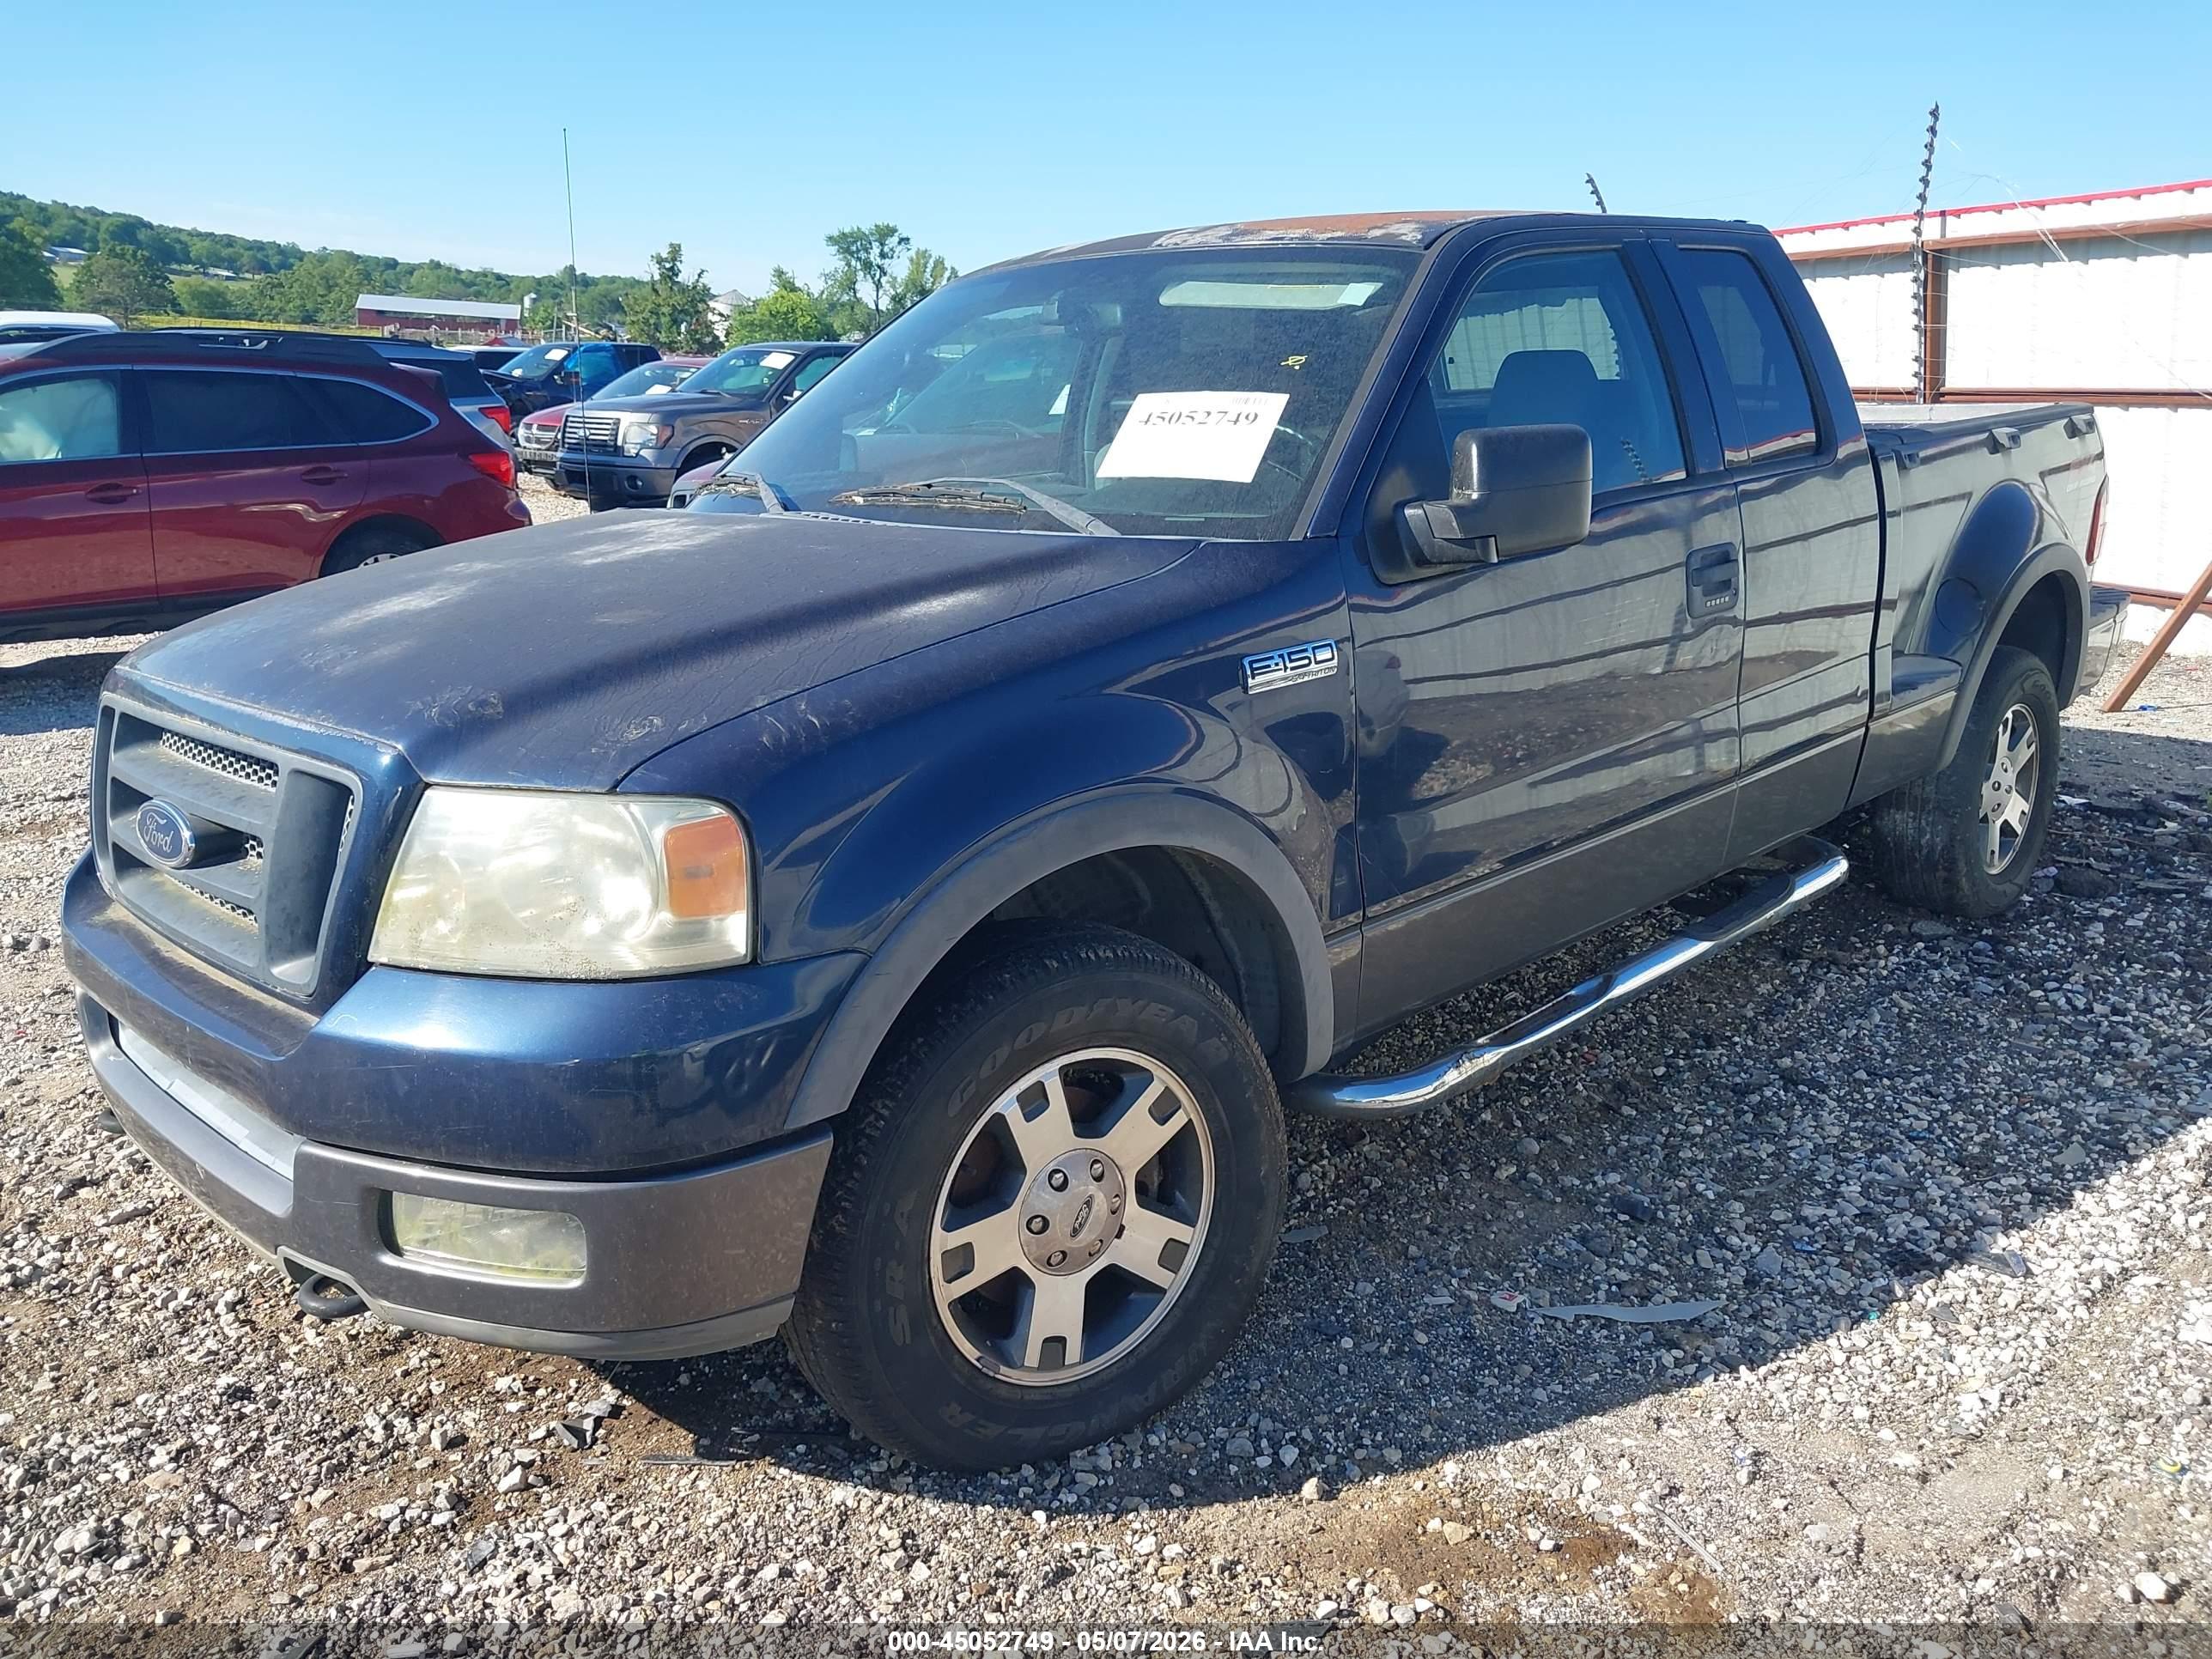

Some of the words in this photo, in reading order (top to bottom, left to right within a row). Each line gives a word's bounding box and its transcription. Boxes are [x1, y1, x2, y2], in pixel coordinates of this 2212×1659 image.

[1139, 410, 1259, 426] 45052749
[1248, 642, 1335, 680] F-150
[143, 811, 174, 854] Ford
[946, 996, 1230, 1119] GOODYEAR
[1073, 1203, 1089, 1230] Ford
